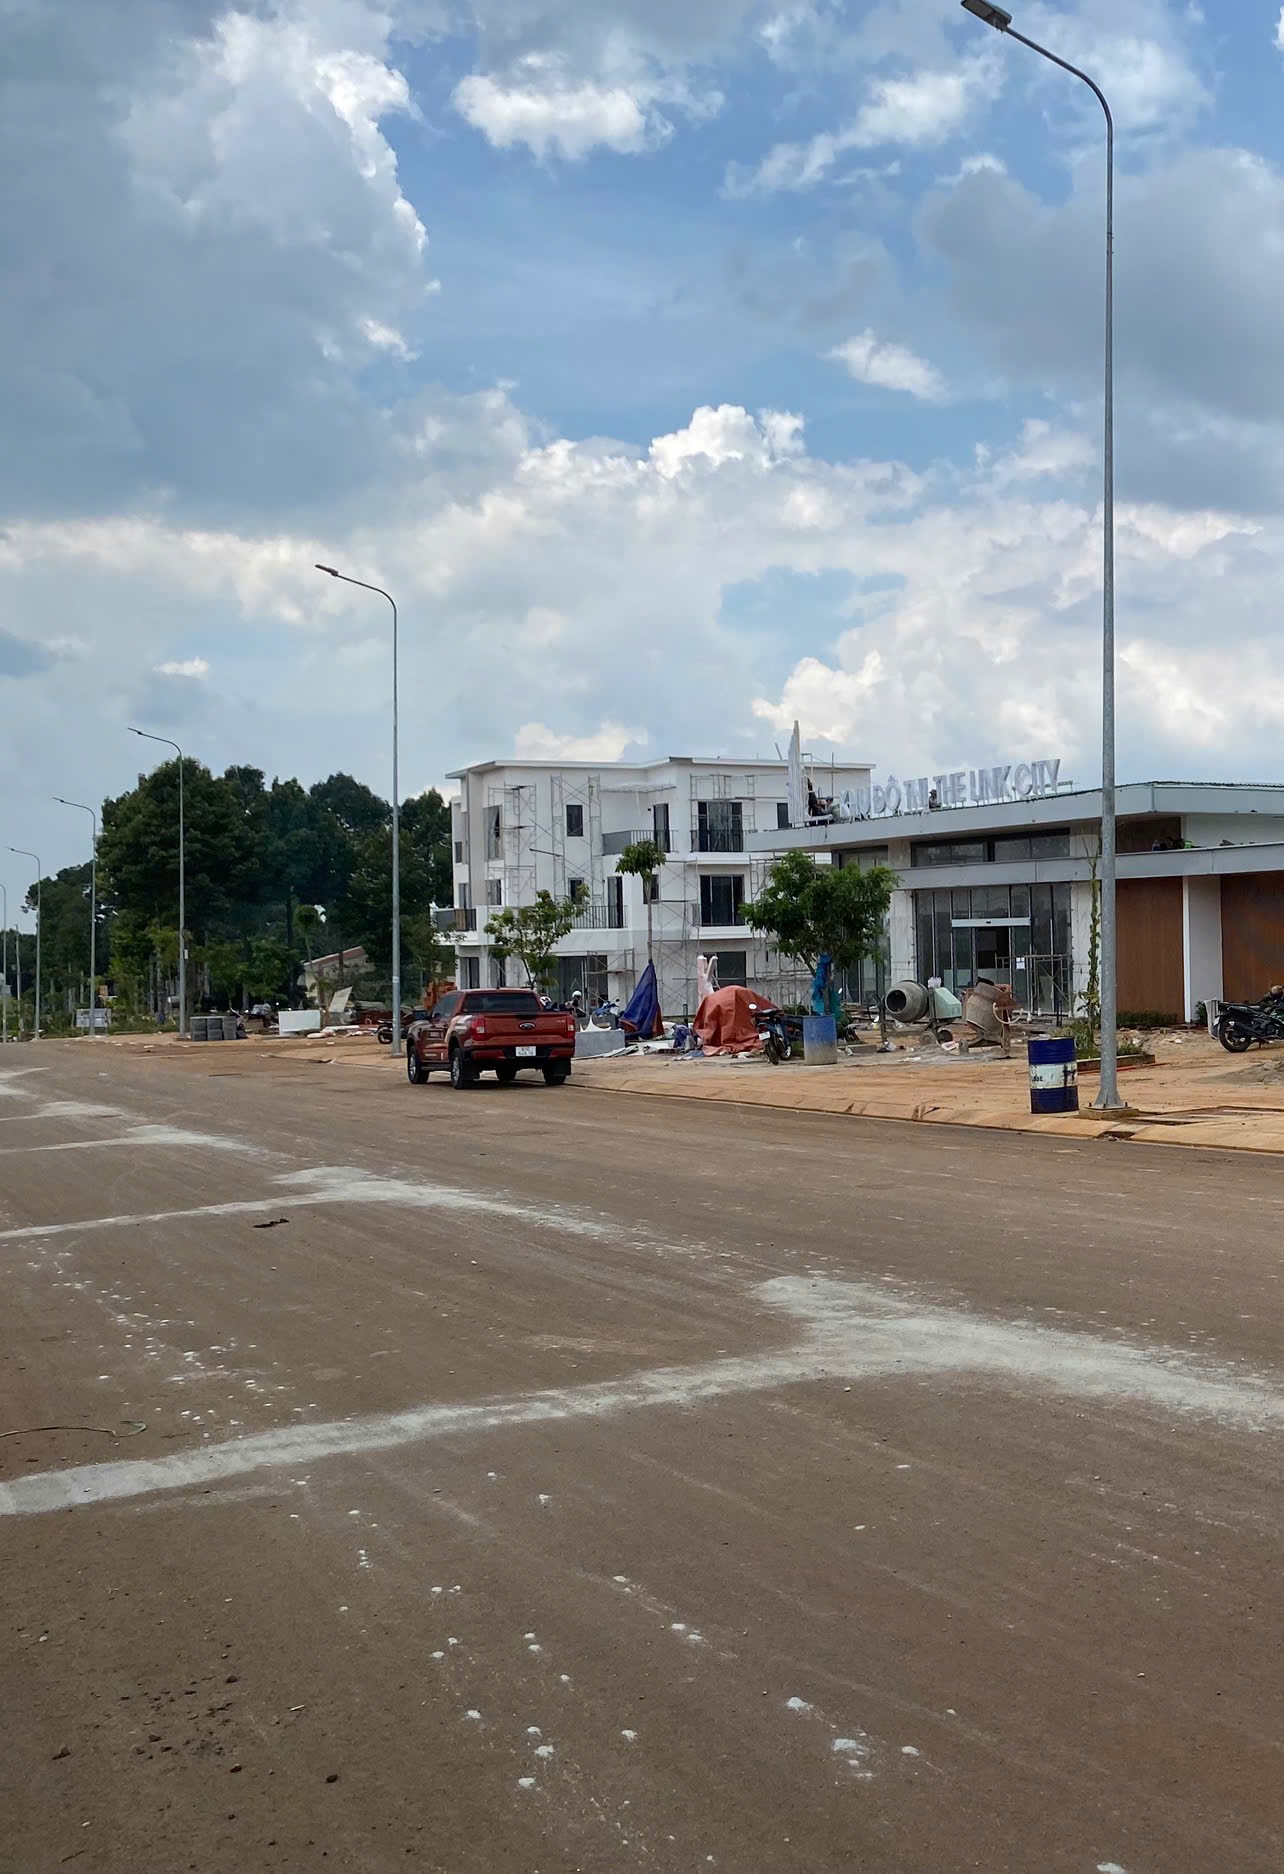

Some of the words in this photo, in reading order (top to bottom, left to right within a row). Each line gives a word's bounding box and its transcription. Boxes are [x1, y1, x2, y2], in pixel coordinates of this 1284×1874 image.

[840, 787, 870, 818] KHU
[873, 775, 900, 813] ĐÔ
[933, 772, 966, 804] THE
[969, 765, 1012, 800] LINK
[1014, 758, 1060, 795] CITY
